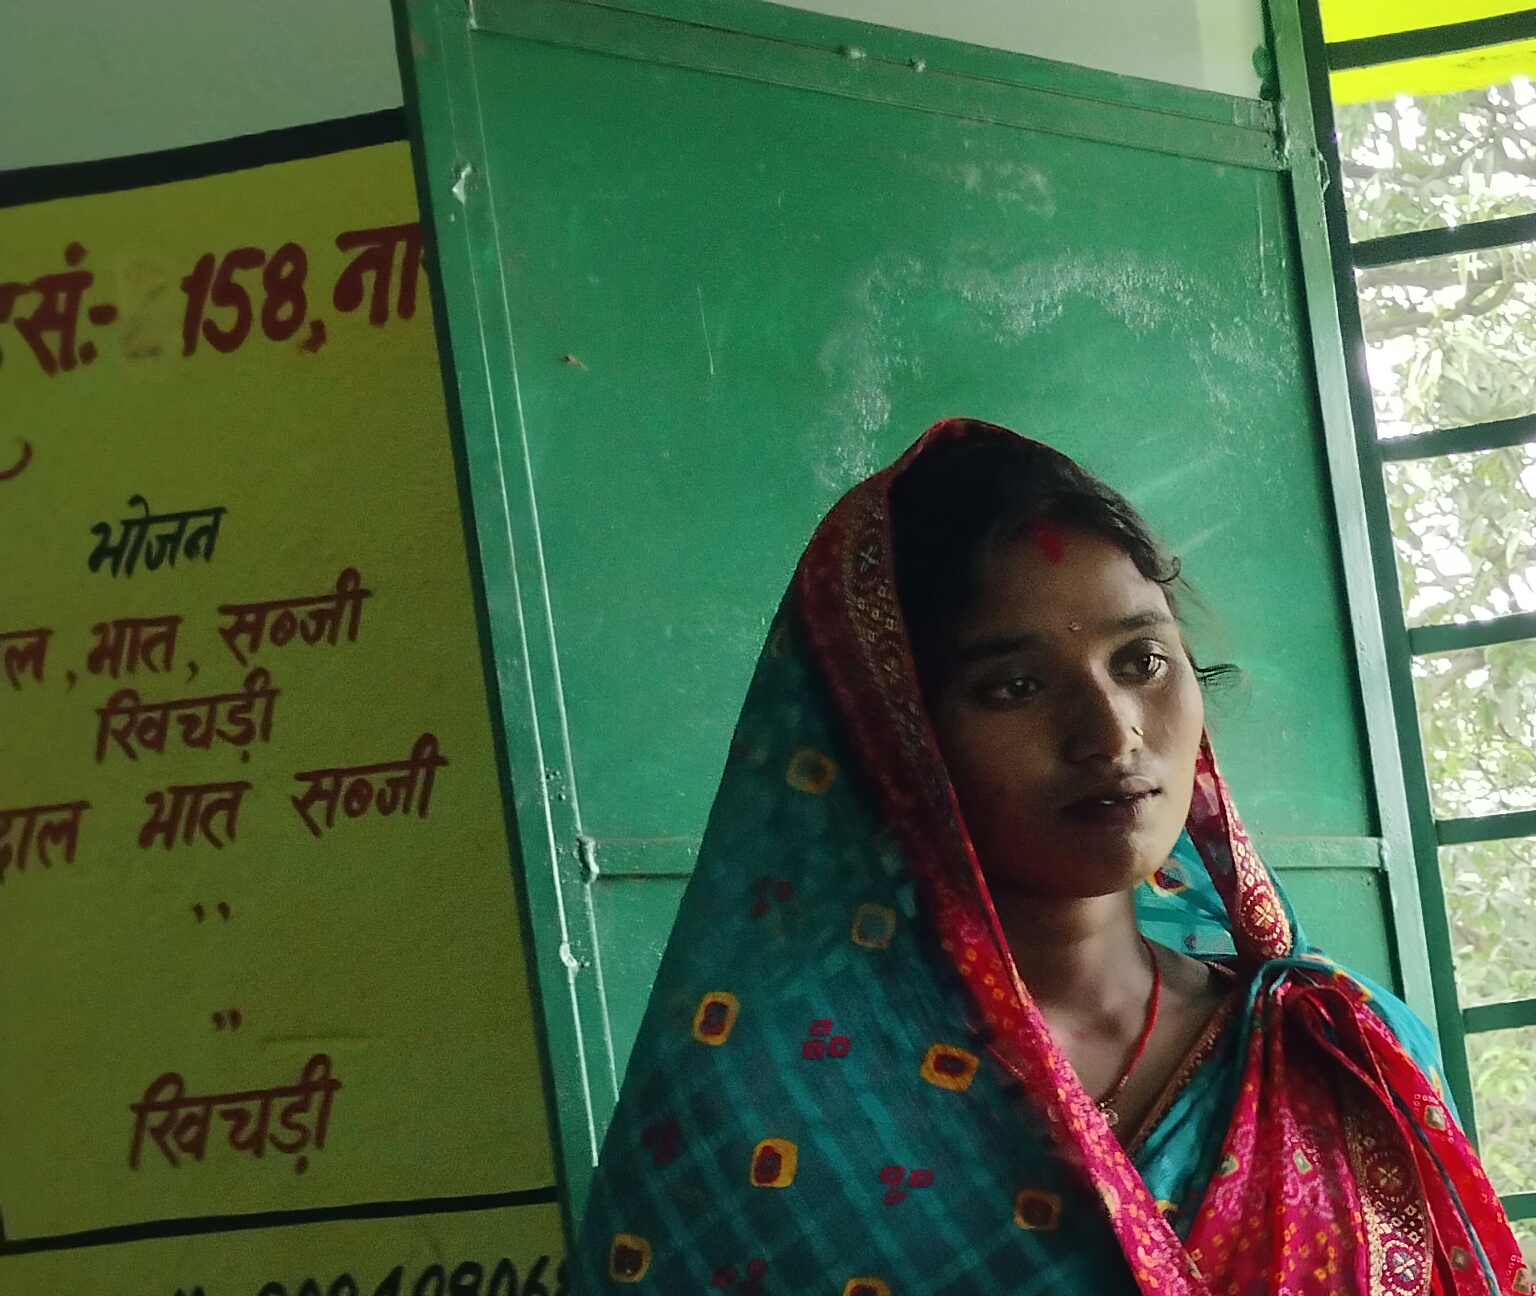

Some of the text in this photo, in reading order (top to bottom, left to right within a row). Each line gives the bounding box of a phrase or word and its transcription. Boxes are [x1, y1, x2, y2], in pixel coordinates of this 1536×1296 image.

[333, 222, 429, 328] ना
[88, 494, 228, 578] भोजन
[217, 567, 373, 666] सब्जी
[95, 667, 281, 763] खिचड़ी
[137, 781, 253, 851] भात
[293, 732, 449, 838] सब्जी
[128, 1054, 342, 1174] खिचड़ी
